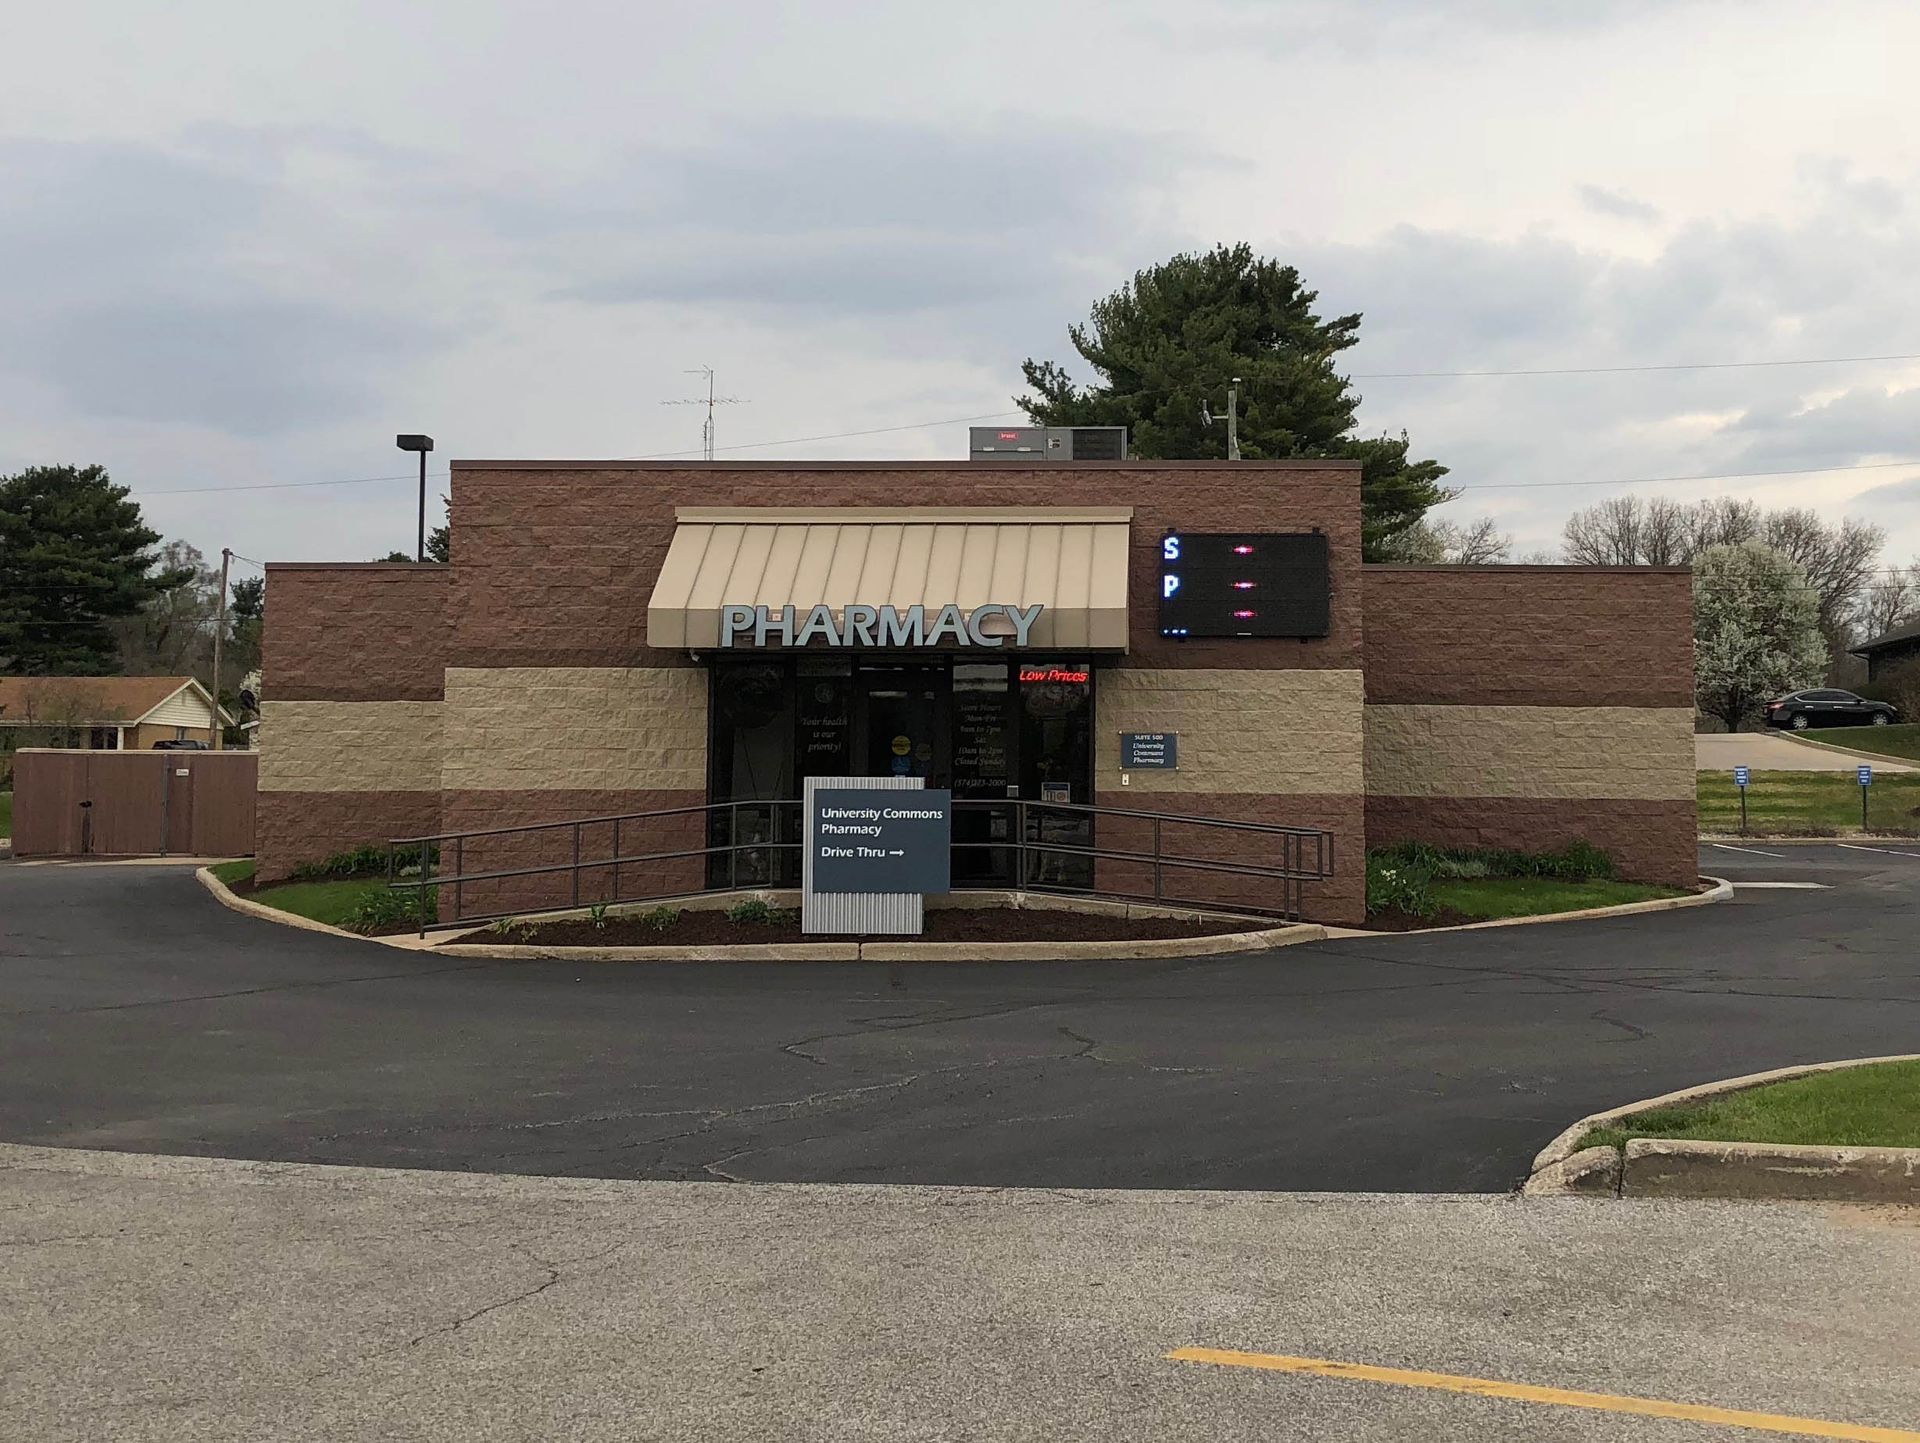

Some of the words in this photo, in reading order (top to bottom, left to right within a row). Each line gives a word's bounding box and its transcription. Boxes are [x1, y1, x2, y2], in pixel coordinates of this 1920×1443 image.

[1164, 537, 1179, 559] S
[1164, 575, 1179, 597] P
[721, 604, 1044, 647] PHARMACY
[1019, 670, 1045, 681] Low
[821, 807, 881, 821] University
[882, 807, 943, 819] Commons
[821, 823, 882, 837] Pharmacy
[821, 846, 854, 857] Drive
[856, 846, 886, 857] Thru
